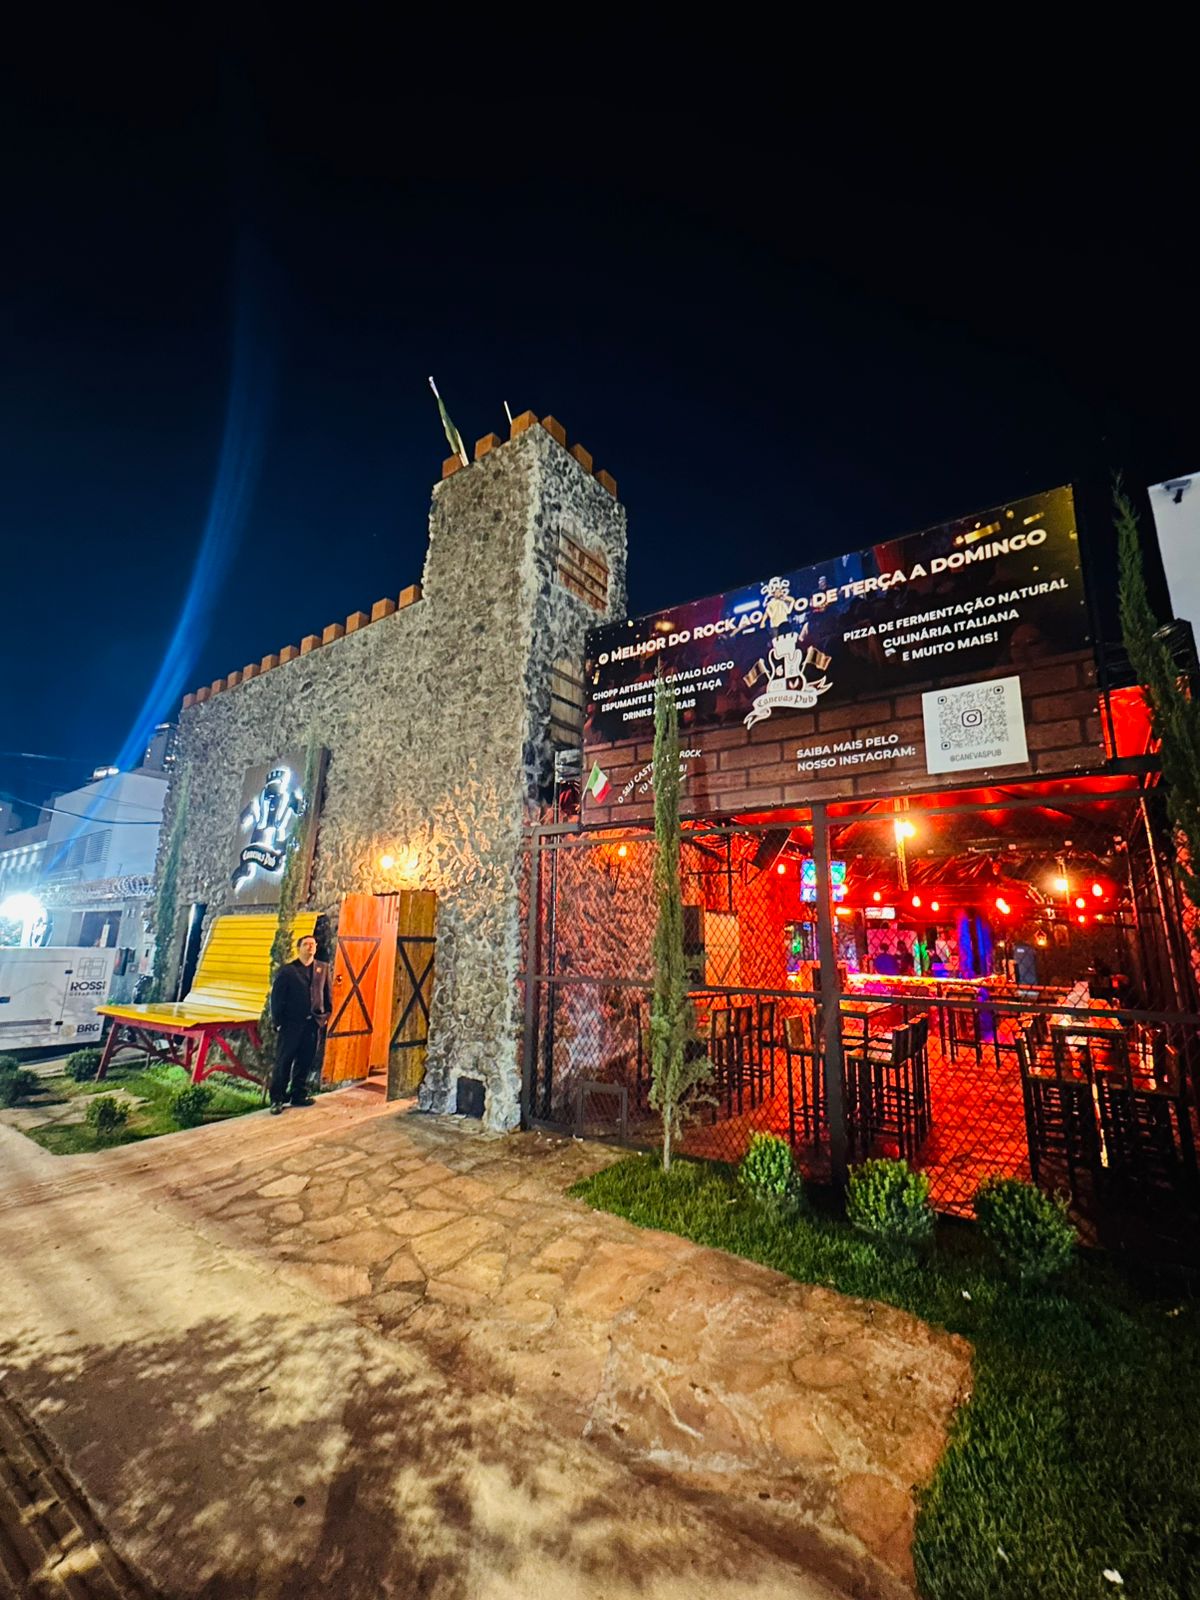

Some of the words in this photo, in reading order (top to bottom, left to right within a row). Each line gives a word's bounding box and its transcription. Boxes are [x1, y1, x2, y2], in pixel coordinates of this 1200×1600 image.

[599, 653, 609, 665] O
[611, 637, 666, 662] MELHOR
[669, 630, 691, 647] DO
[694, 616, 736, 640] ROCK
[739, 610, 763, 629] AO
[812, 588, 838, 608] DE
[840, 570, 906, 599] TERÇA
[909, 564, 927, 580] A
[931, 528, 1047, 575] DOMINGO
[843, 625, 877, 642] PIZZA
[878, 620, 894, 633] DE
[896, 595, 995, 629] FERMENTAÇÃO
[998, 577, 1068, 604] NATURAL
[883, 624, 951, 649] CULINÁRIA
[954, 608, 1019, 632] ITALIANA
[902, 650, 910, 662] E
[912, 641, 955, 660] MUITO
[957, 631, 999, 650] MAIS!
[592, 687, 618, 701] CHOPP
[619, 678, 664, 695] ARTESANAL
[665, 668, 701, 684] CAVALO
[702, 660, 734, 676] LOUCO
[602, 695, 647, 712] ESPUMANTE
[648, 693, 653, 702] E
[682, 683, 696, 695] NA
[696, 678, 722, 691] TAÇA
[794, 694, 814, 705] Pub
[623, 708, 652, 721] DRINKS
[796, 744, 831, 759] SAIBA
[833, 740, 862, 754] MAIS
[866, 734, 899, 749] PELO
[797, 757, 837, 772] NOSSO
[839, 746, 916, 766] INSTAGRAM:
[949, 748, 1002, 763] @CANEVASPUB
[622, 781, 634, 796] SEU
[679, 749, 702, 759] ROCK
[70, 980, 106, 991] ROSSI
[77, 1023, 100, 1033] BRG
